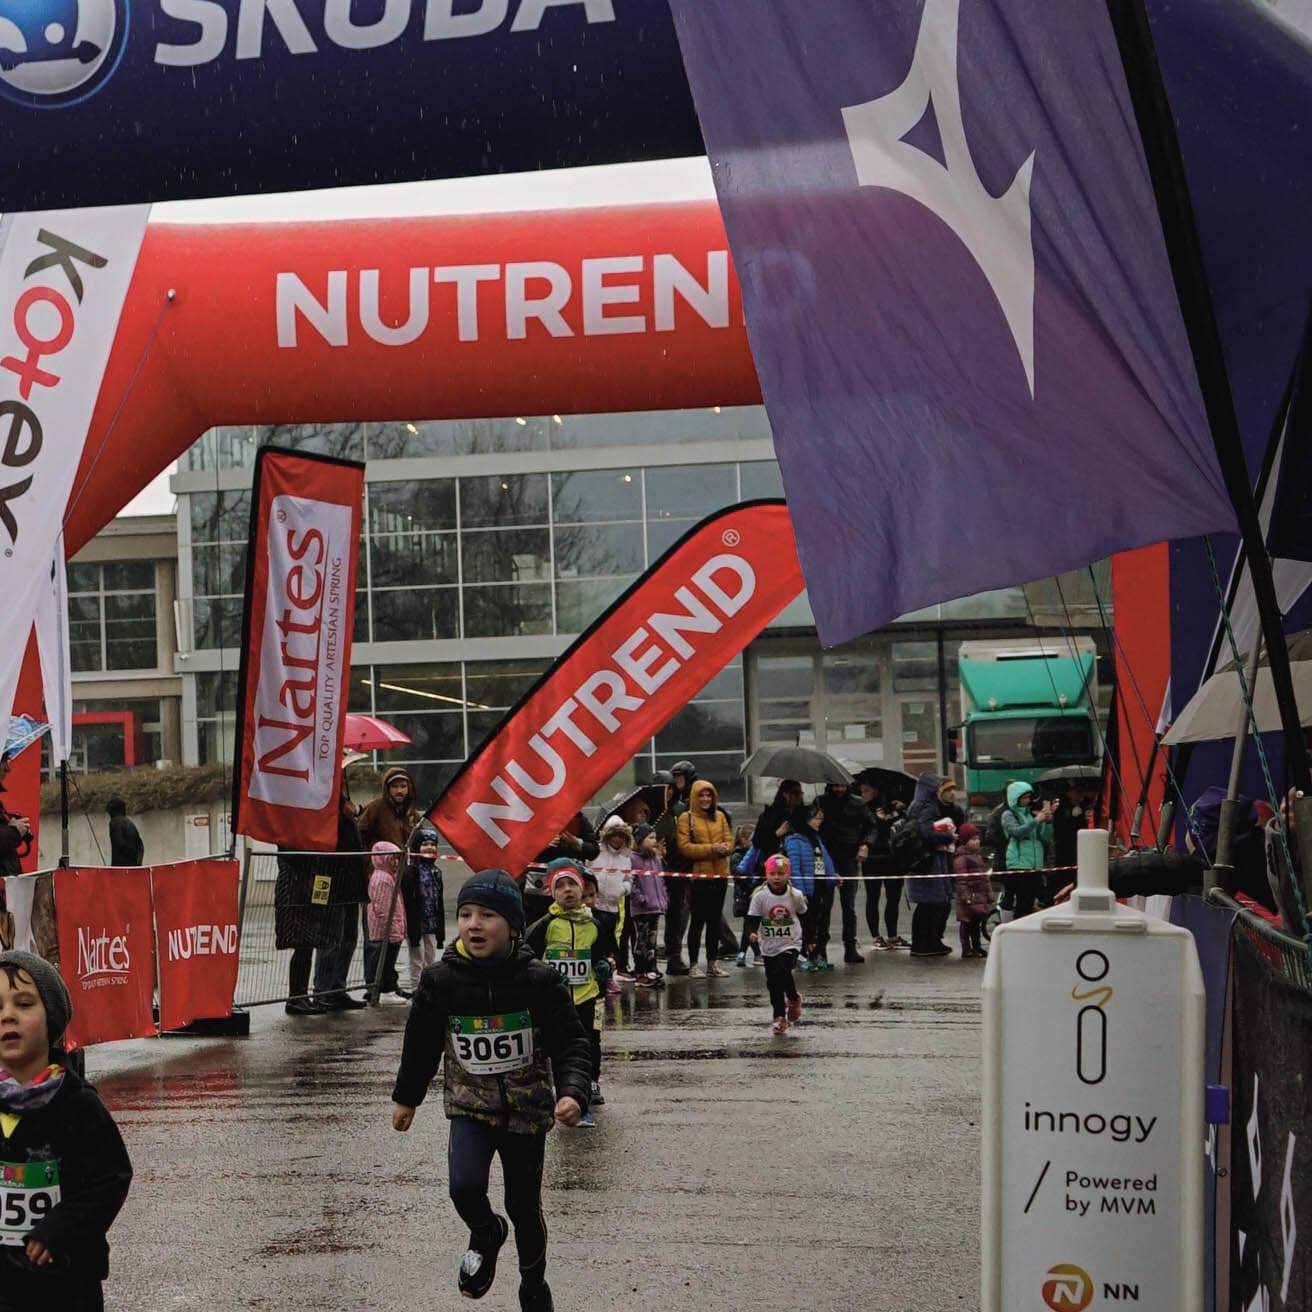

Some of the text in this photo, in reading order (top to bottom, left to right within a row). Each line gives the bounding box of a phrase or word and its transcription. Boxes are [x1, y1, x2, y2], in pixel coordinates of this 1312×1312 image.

[276, 250, 748, 349] NUTREN
[258, 528, 325, 783] Nartes
[318, 556, 342, 761] TOP QUALITY ARTESIAN SPRING
[466, 554, 756, 849] NUTREND
[77, 926, 130, 976] Nartes
[764, 927, 791, 938] 3144
[457, 1033, 524, 1061] 3061
[1024, 1102, 1158, 1143] innogy
[1065, 1170, 1158, 1191] Powered
[1065, 1193, 1156, 1217] by MVM
[1103, 1283, 1139, 1301] NN
